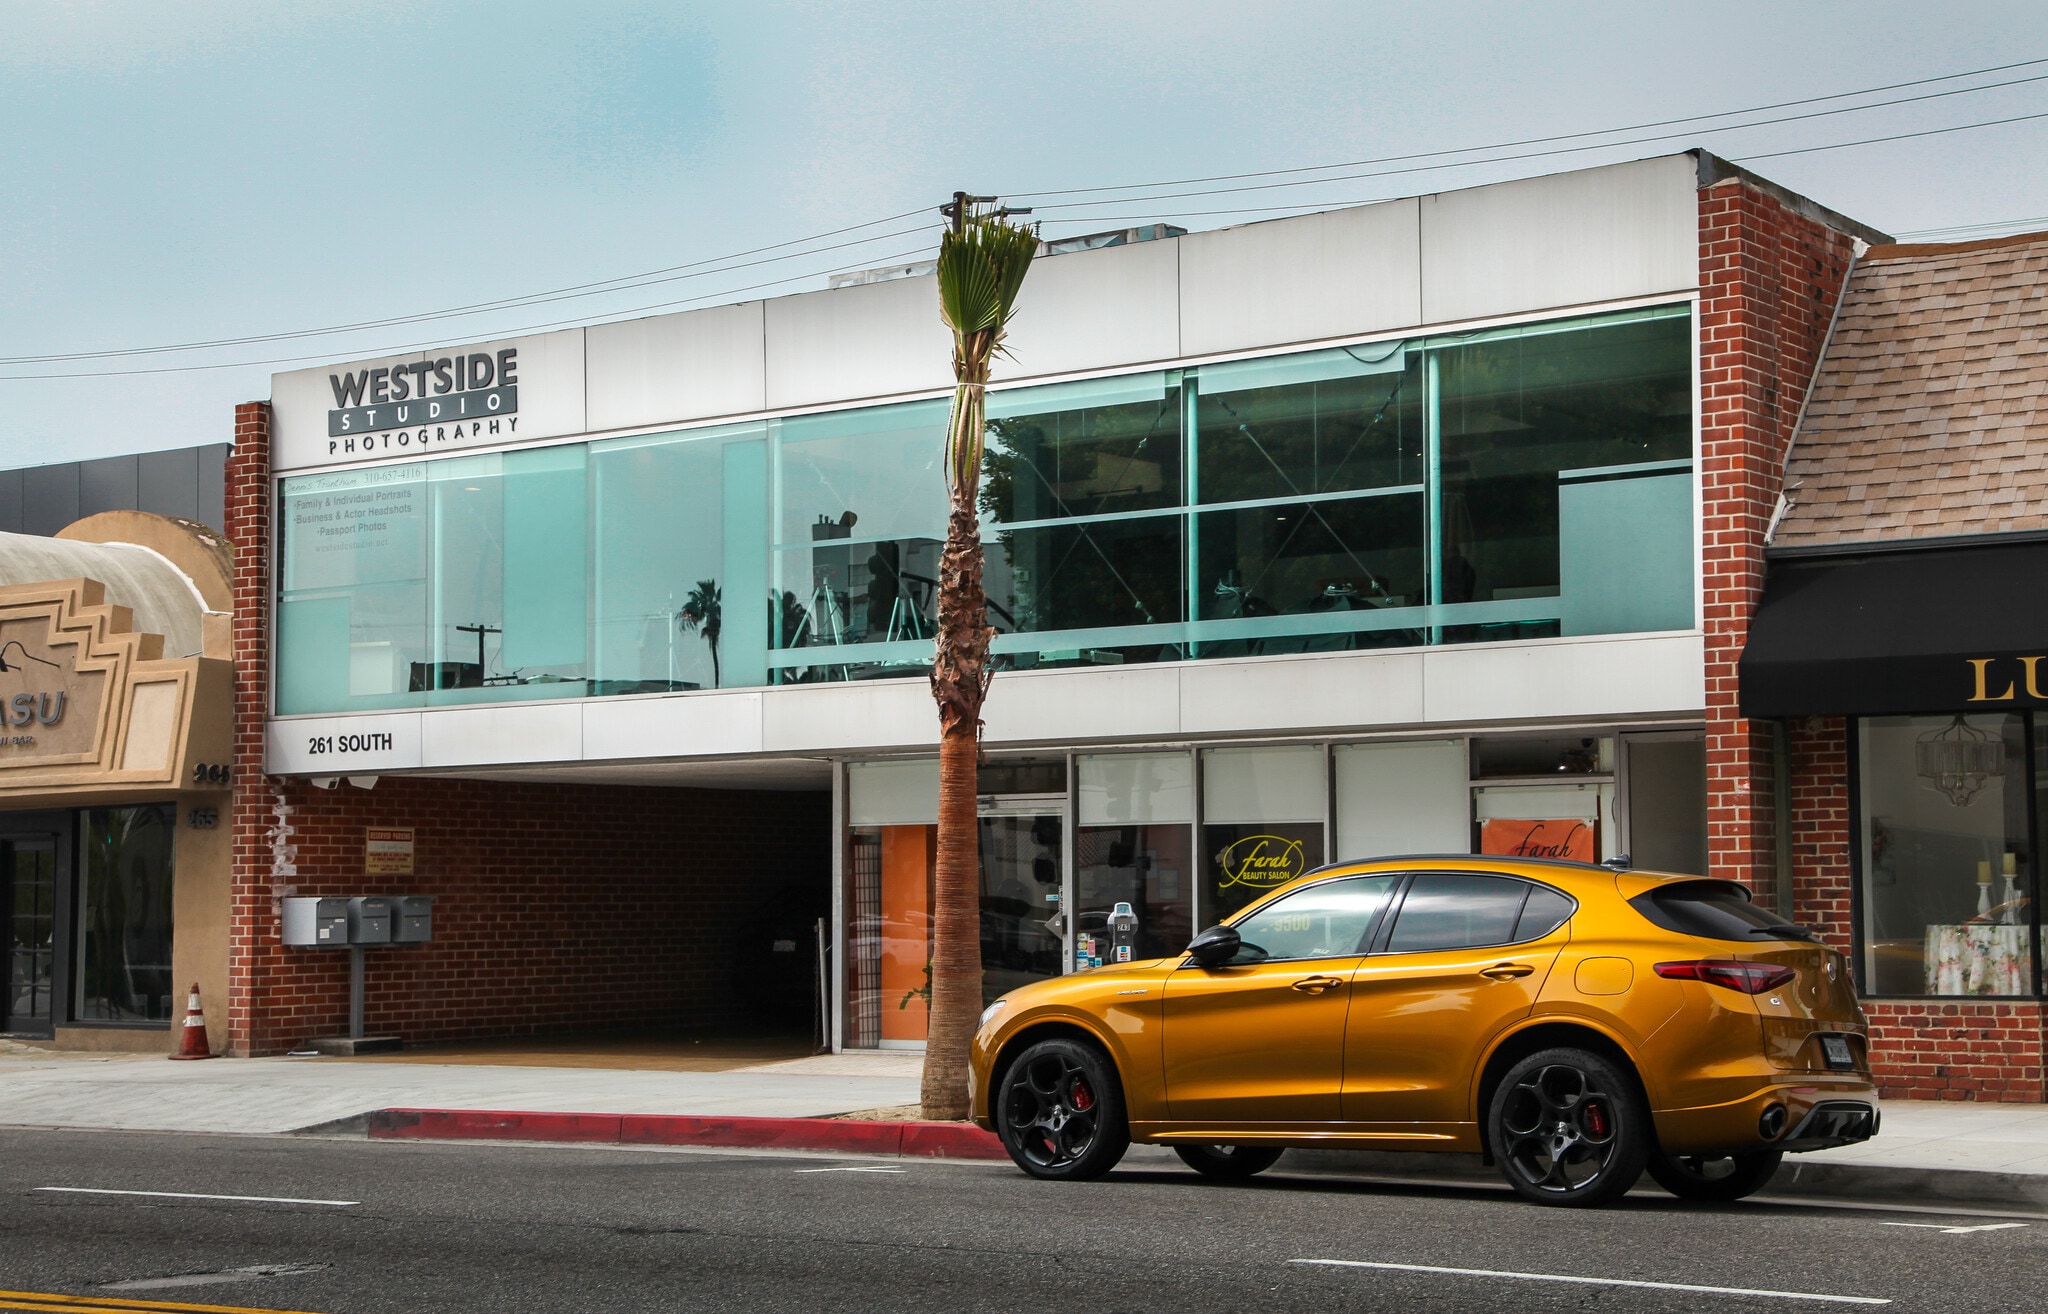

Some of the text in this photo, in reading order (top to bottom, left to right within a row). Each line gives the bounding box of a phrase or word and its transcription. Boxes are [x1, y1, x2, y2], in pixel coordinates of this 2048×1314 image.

[329, 348, 518, 408] WESTSIDE
[341, 393, 501, 430] STUDIO
[329, 417, 518, 454] PHOTOGRAPHY
[364, 467, 421, 484] 310-657-4116
[325, 497, 331, 506] &
[333, 492, 374, 505] Individual
[376, 490, 412, 501] Portraits
[335, 511, 341, 520] &
[344, 508, 366, 519] Actor
[368, 504, 412, 517] Headshots
[358, 522, 387, 532] Photos
[0, 691, 64, 726] SU
[308, 733, 392, 754] 261 SOUTH
[193, 763, 231, 784] 265
[1242, 871, 1290, 880] BEAUTY SALON
